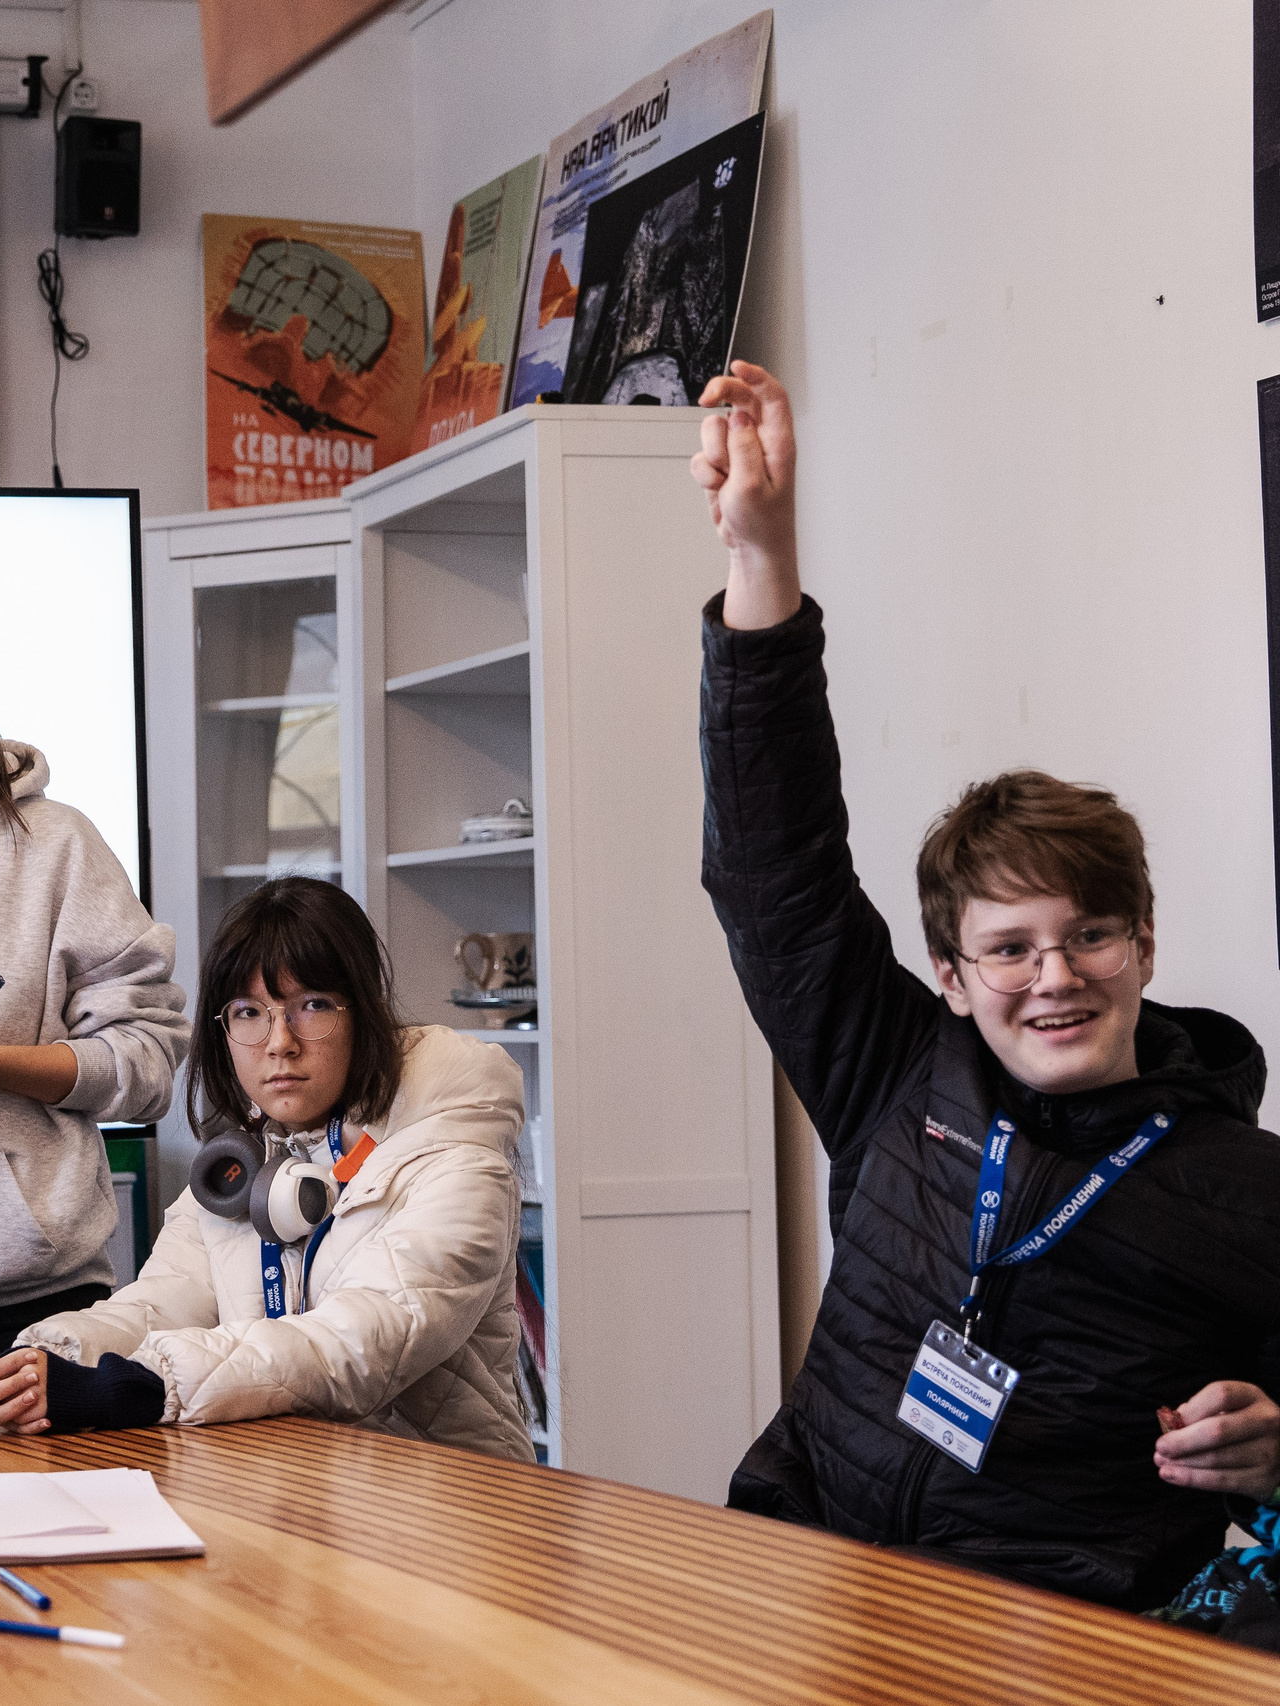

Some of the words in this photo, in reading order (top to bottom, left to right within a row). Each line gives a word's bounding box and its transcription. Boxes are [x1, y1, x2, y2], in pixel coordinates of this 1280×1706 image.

[588, 79, 670, 167] АРКТИКОЙ
[232, 412, 259, 428] НА
[232, 430, 375, 473] СЕВЕРНОМ
[233, 463, 365, 504] ПОЛЮС
[996, 1134, 1010, 1165] ПОЛЮСА
[224, 1163, 241, 1183] R
[1042, 1172, 1106, 1238] ПОКОЛЕНИЙ
[273, 1283, 281, 1311] ПОЛЮСА
[921, 1359, 949, 1382] ВСТРЕЧА
[950, 1377, 992, 1408] ПОКОЛЕНИЙ
[926, 1389, 970, 1422] ПОЛЯРНИКИ
